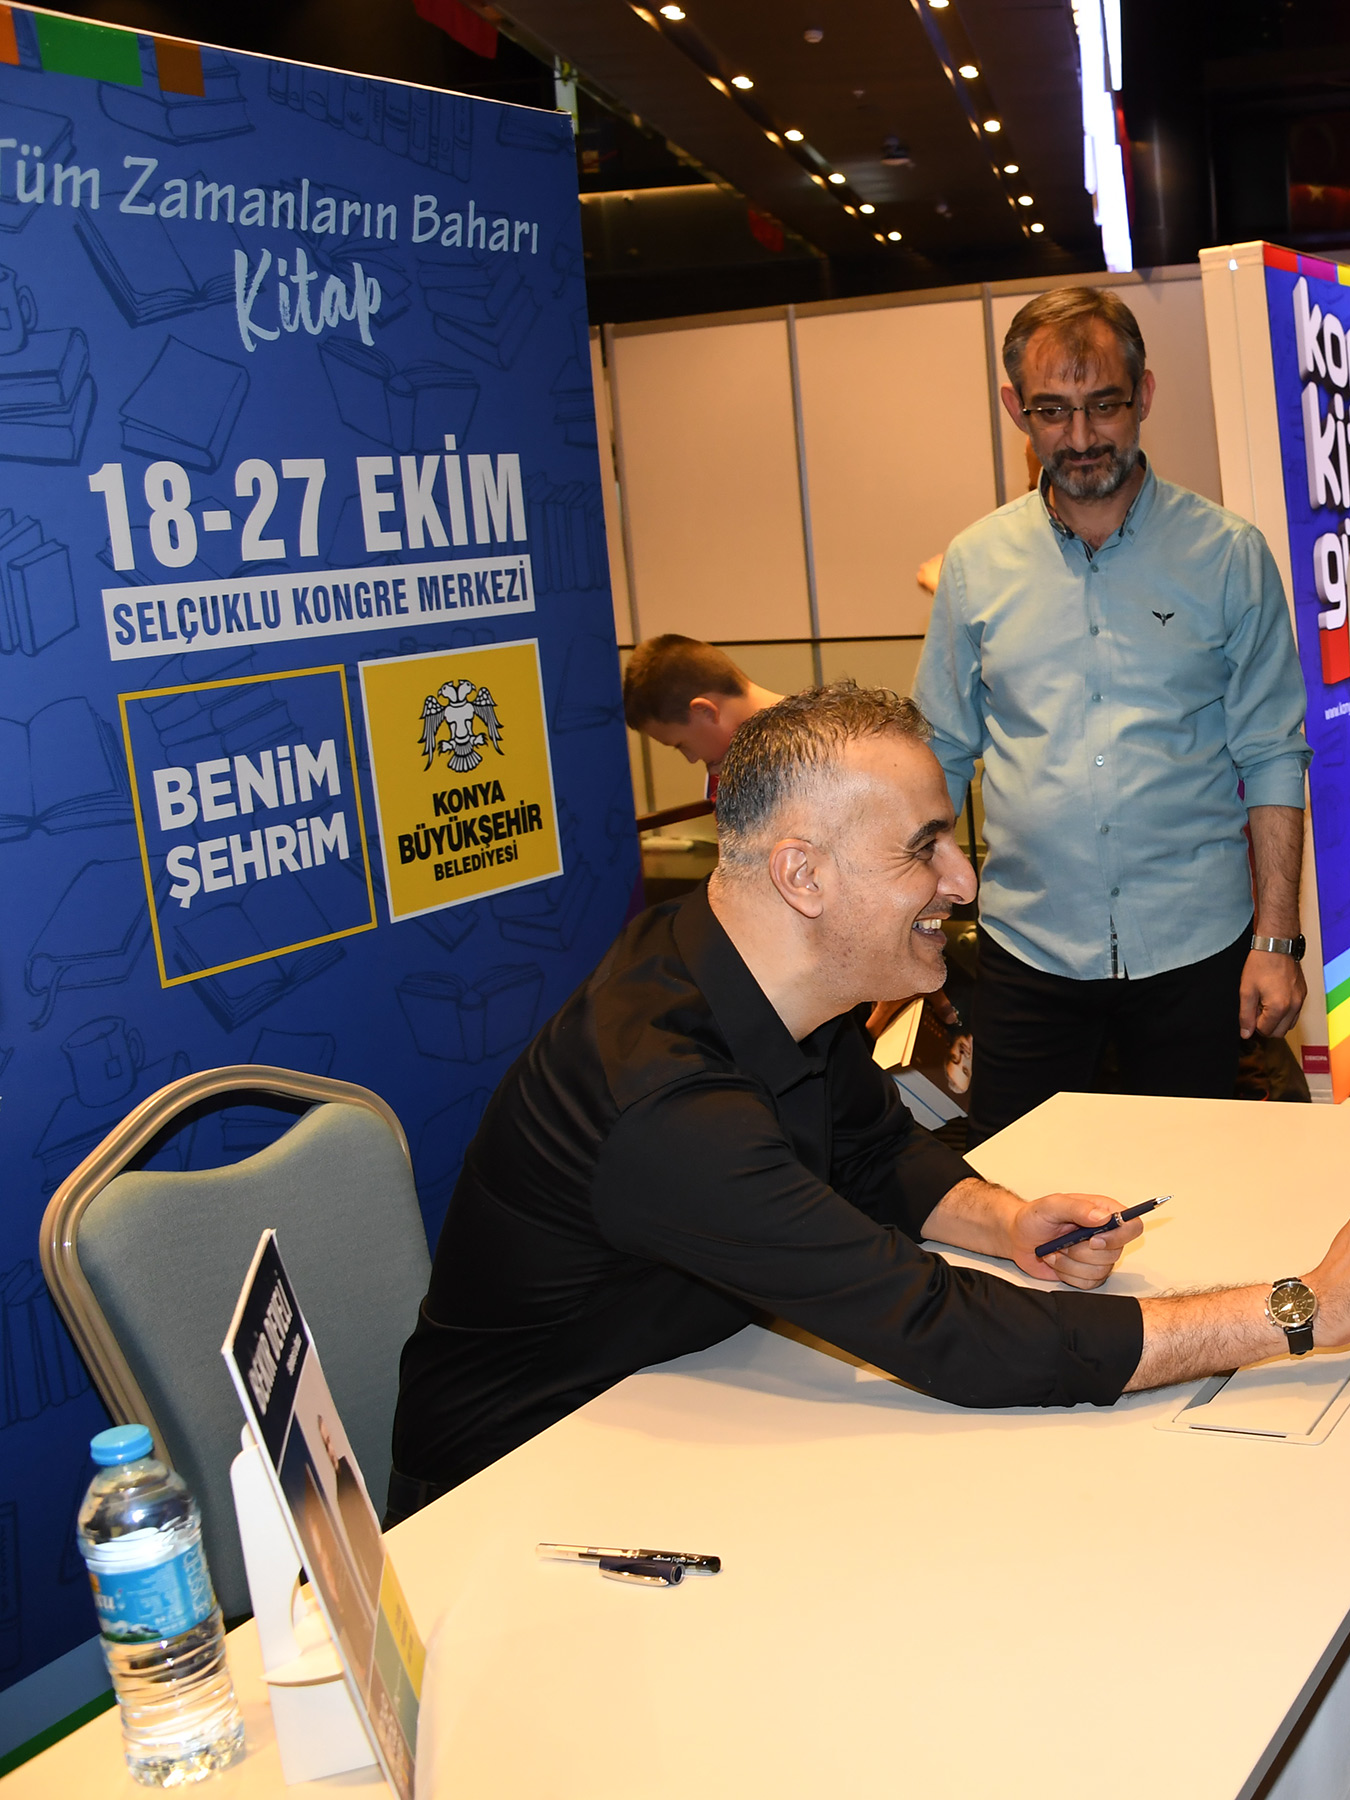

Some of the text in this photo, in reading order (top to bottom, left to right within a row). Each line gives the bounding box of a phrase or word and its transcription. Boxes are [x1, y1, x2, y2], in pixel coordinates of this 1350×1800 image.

[119, 155, 398, 241] Zamanların
[411, 194, 539, 254] Baharı
[234, 247, 382, 353] Kitap
[88, 434, 528, 572] 18-27 EKİM
[112, 560, 529, 645] SELÇUKLU KONGRE MERKEZİ
[397, 800, 544, 865] BÜYÜKŞEHİR
[432, 779, 506, 817] KONYA
[433, 840, 519, 882] BELEDİYESİ
